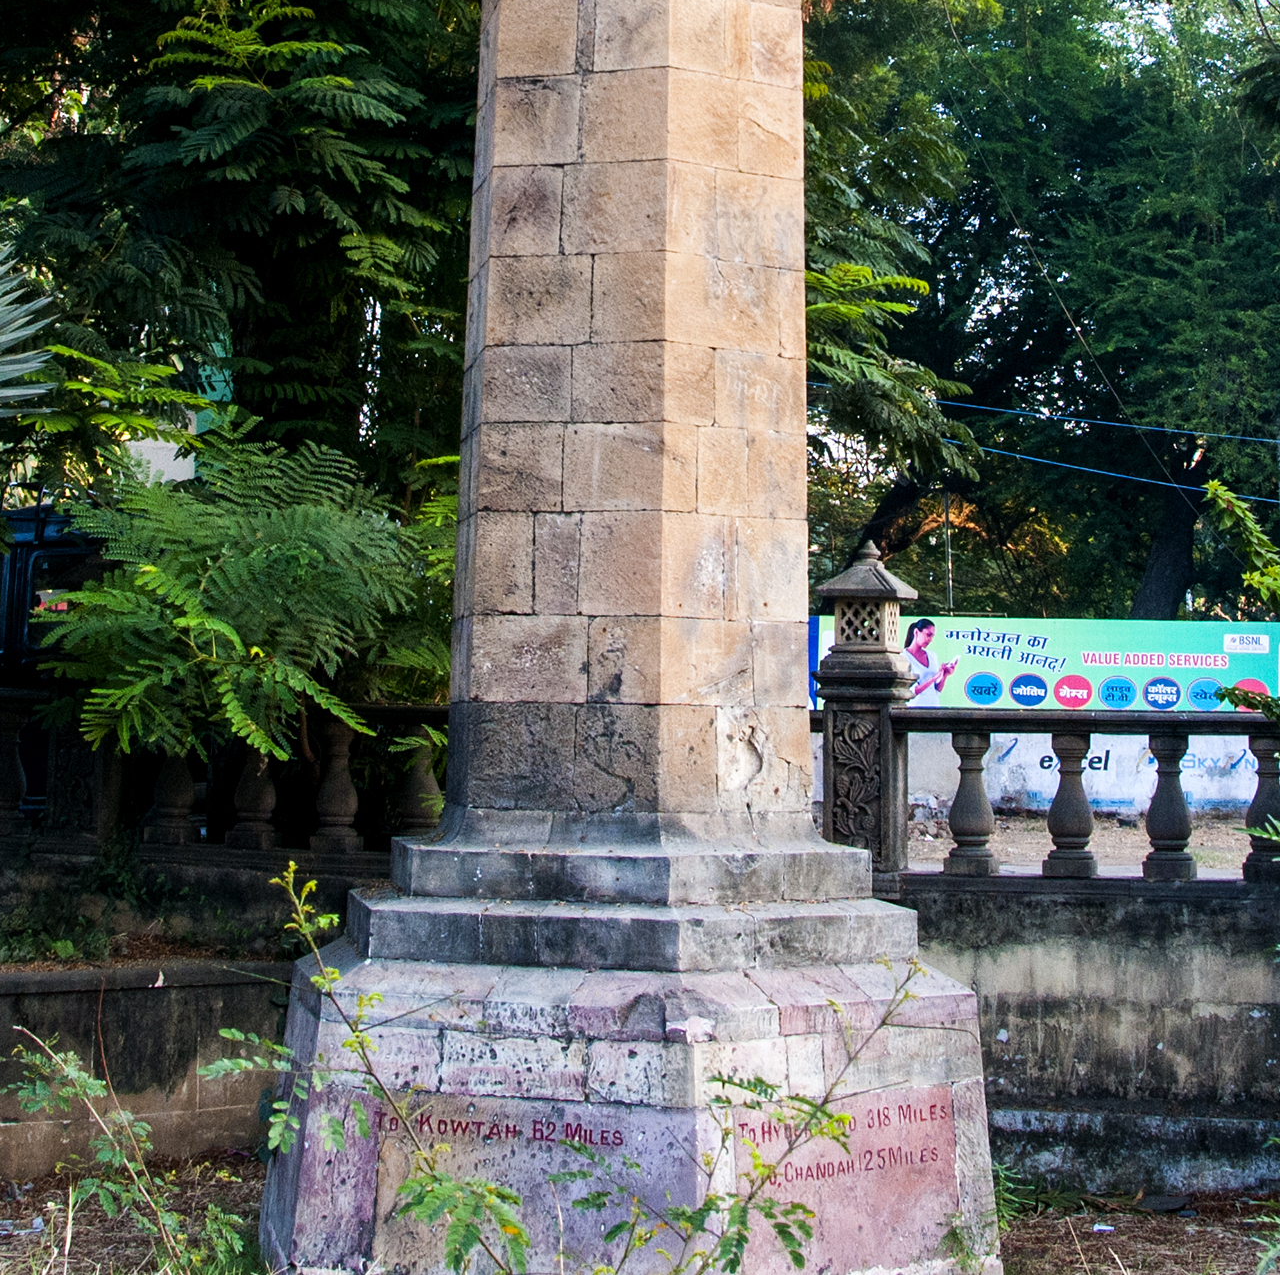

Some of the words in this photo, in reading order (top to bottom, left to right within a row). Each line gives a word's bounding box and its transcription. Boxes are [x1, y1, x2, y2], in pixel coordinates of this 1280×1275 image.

[945, 627, 1022, 645] मनोरंजन
[1027, 635, 1049, 650] का
[1239, 635, 1263, 646] BSNL
[965, 644, 1013, 661] असली
[1082, 653, 1120, 665] VALUE
[1124, 653, 1164, 666] ADDED
[1169, 654, 1228, 667] SERVICES
[1059, 685, 1088, 699] गेम्स
[867, 1106, 891, 1130] 318
[898, 1103, 947, 1125] MILES
[418, 1113, 518, 1139] KOWTAH
[564, 1121, 624, 1147] MILES
[888, 1145, 939, 1168] MILES
